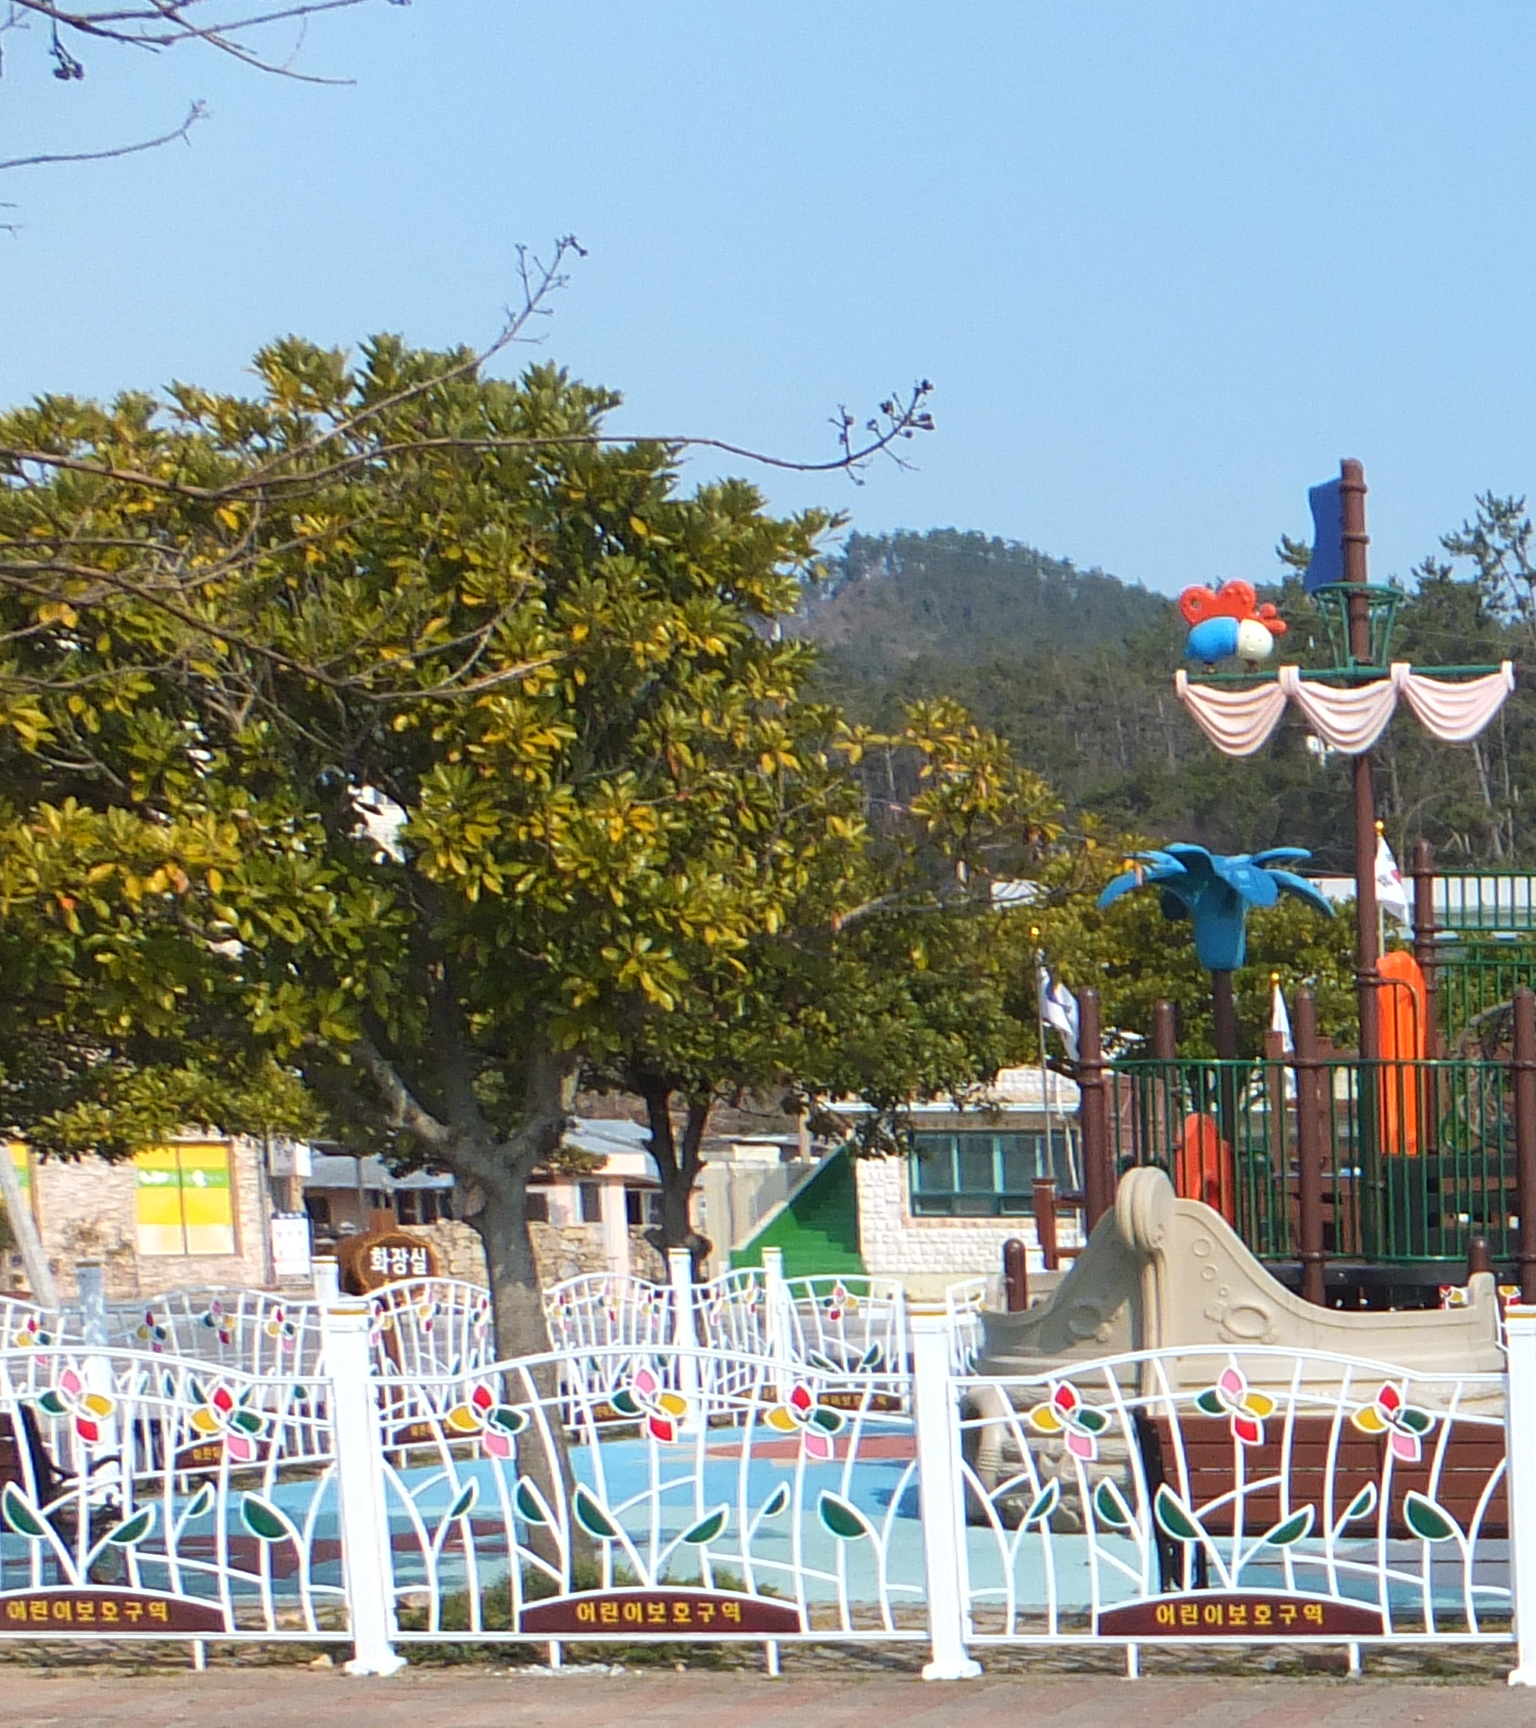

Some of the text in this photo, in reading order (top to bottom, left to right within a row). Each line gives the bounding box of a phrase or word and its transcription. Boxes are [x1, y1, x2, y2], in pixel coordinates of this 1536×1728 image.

[369, 1246, 427, 1275] 화장실
[7, 1600, 169, 1622] 어린이보호구역
[576, 1602, 742, 1623] 어린이보호구역
[1156, 1604, 1324, 1626] 어린이보호구역
